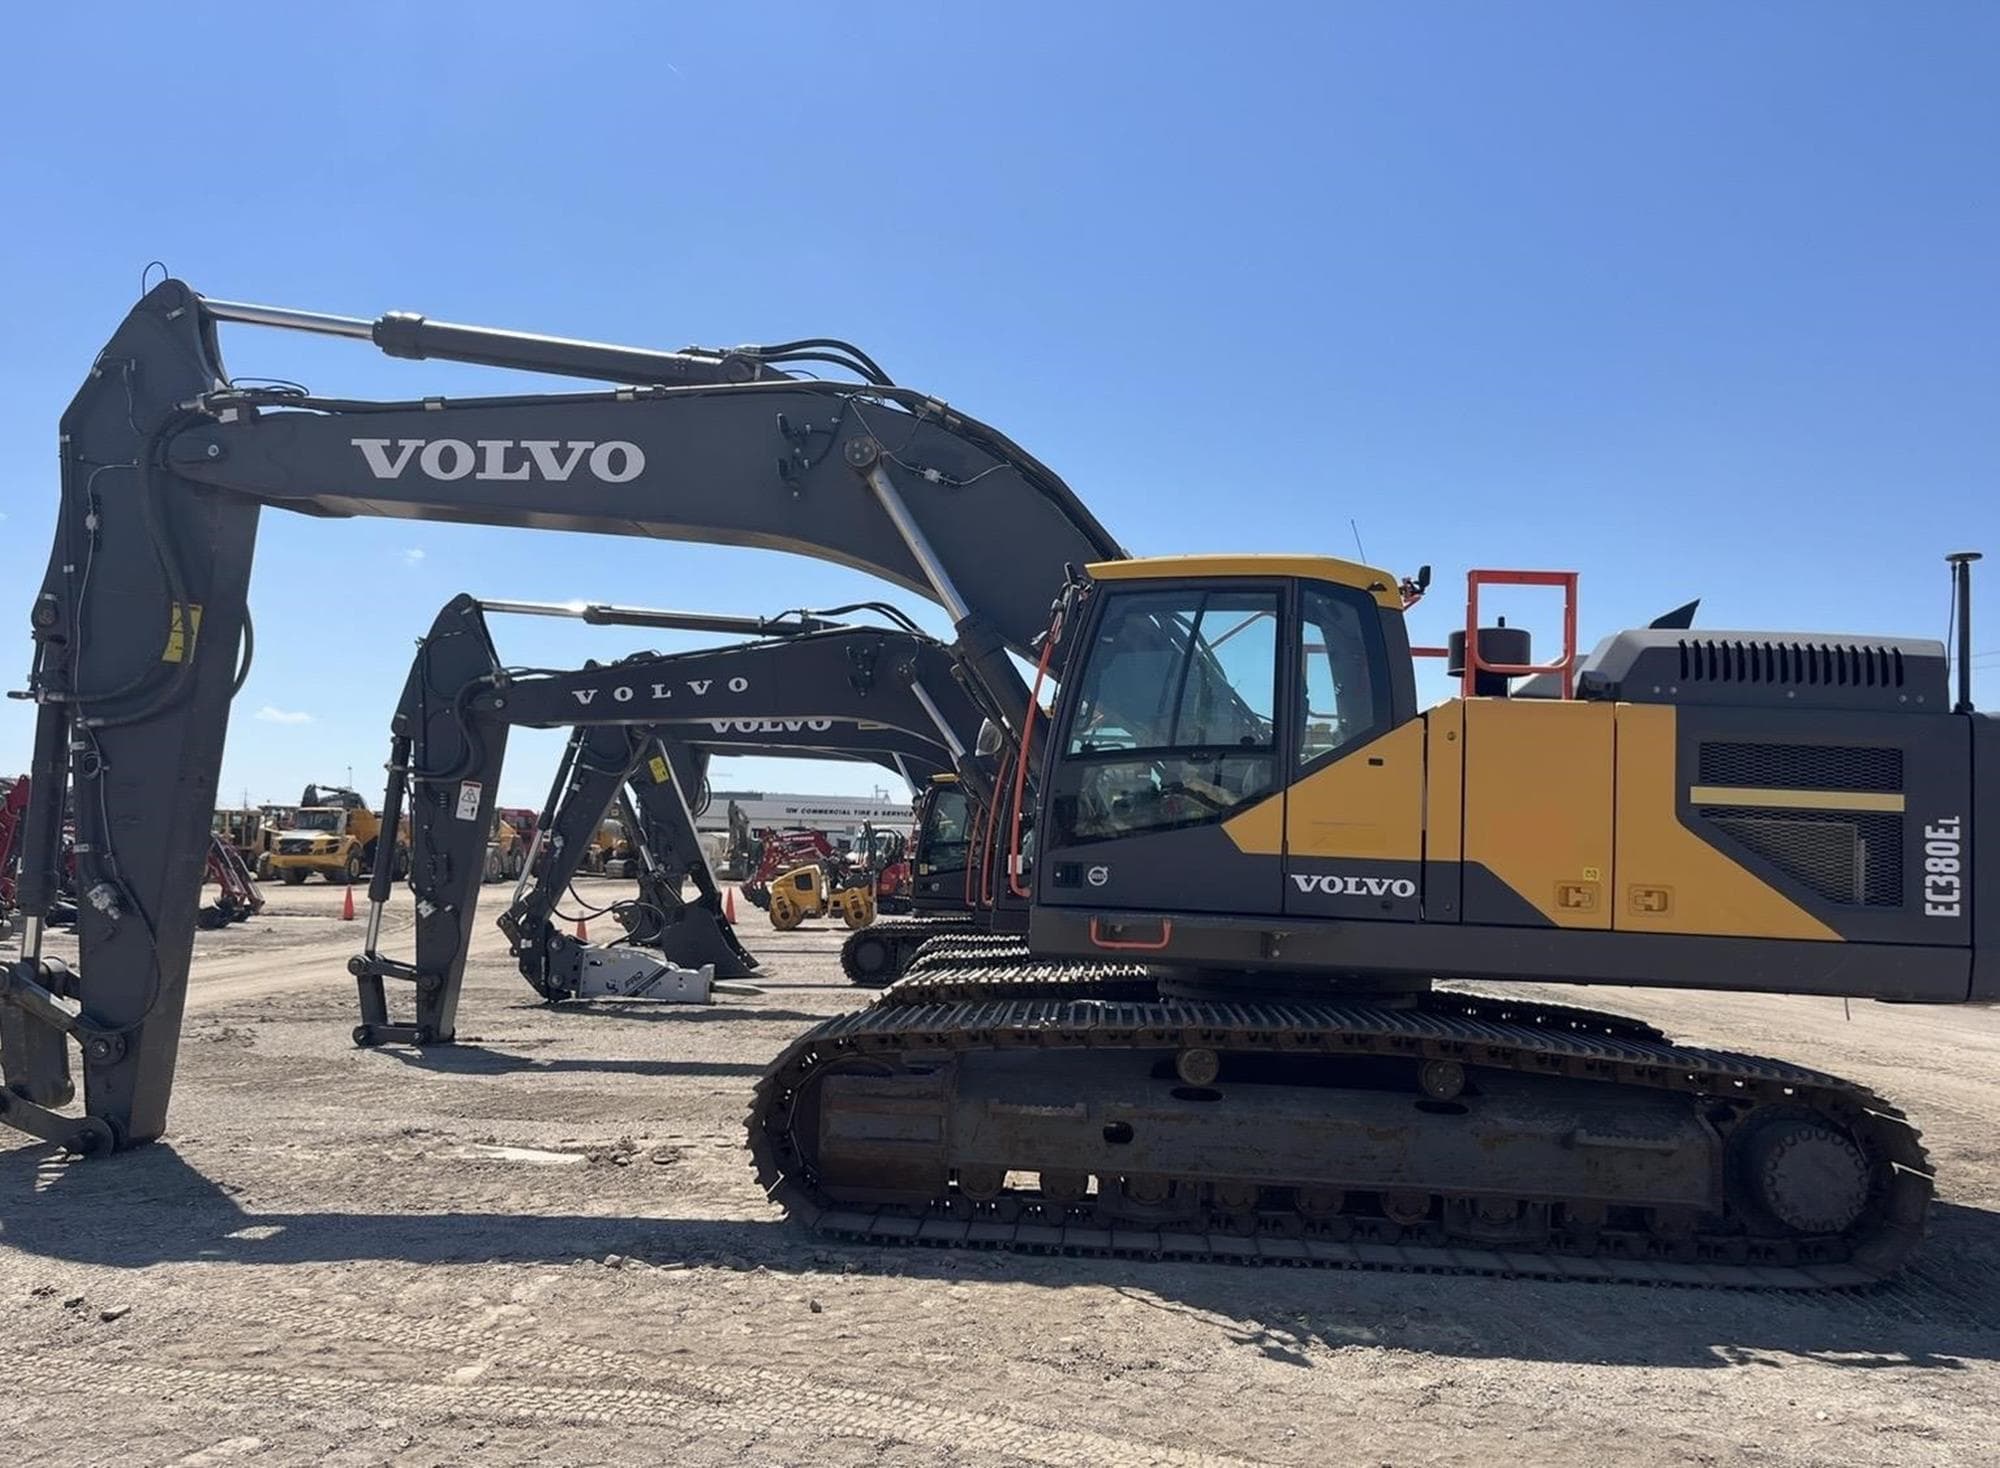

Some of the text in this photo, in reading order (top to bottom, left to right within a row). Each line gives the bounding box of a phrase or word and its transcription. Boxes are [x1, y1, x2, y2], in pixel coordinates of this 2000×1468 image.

[351, 438, 645, 483] VOLVO
[572, 677, 748, 705] VOLVO
[709, 719, 833, 734] VOLVO
[1291, 874, 1416, 897] VOLVO
